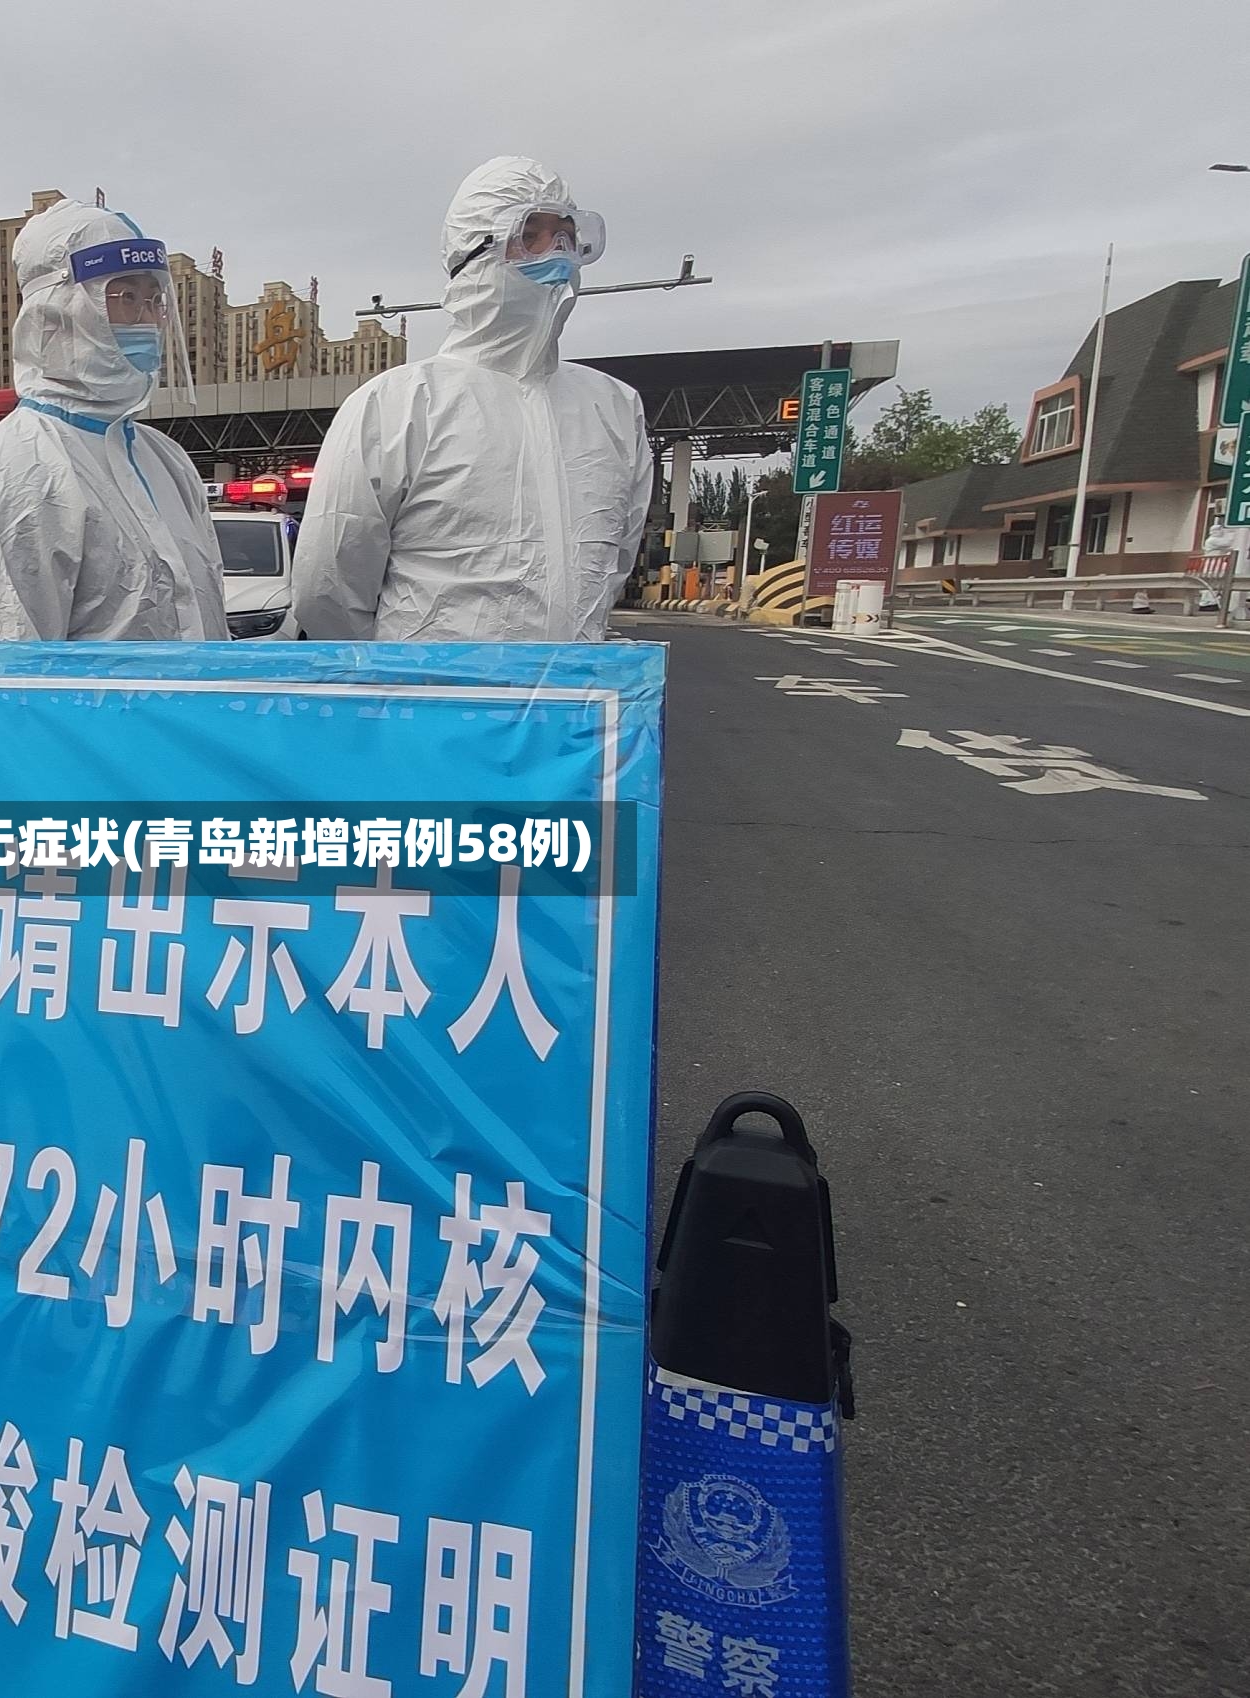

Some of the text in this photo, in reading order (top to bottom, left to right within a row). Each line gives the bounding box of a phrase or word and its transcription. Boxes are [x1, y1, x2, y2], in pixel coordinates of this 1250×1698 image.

[121, 247, 155, 264] Face
[801, 377, 824, 468] 客货混合车道
[821, 382, 844, 460] 绿色通道
[655, 1609, 780, 1698] 警察
